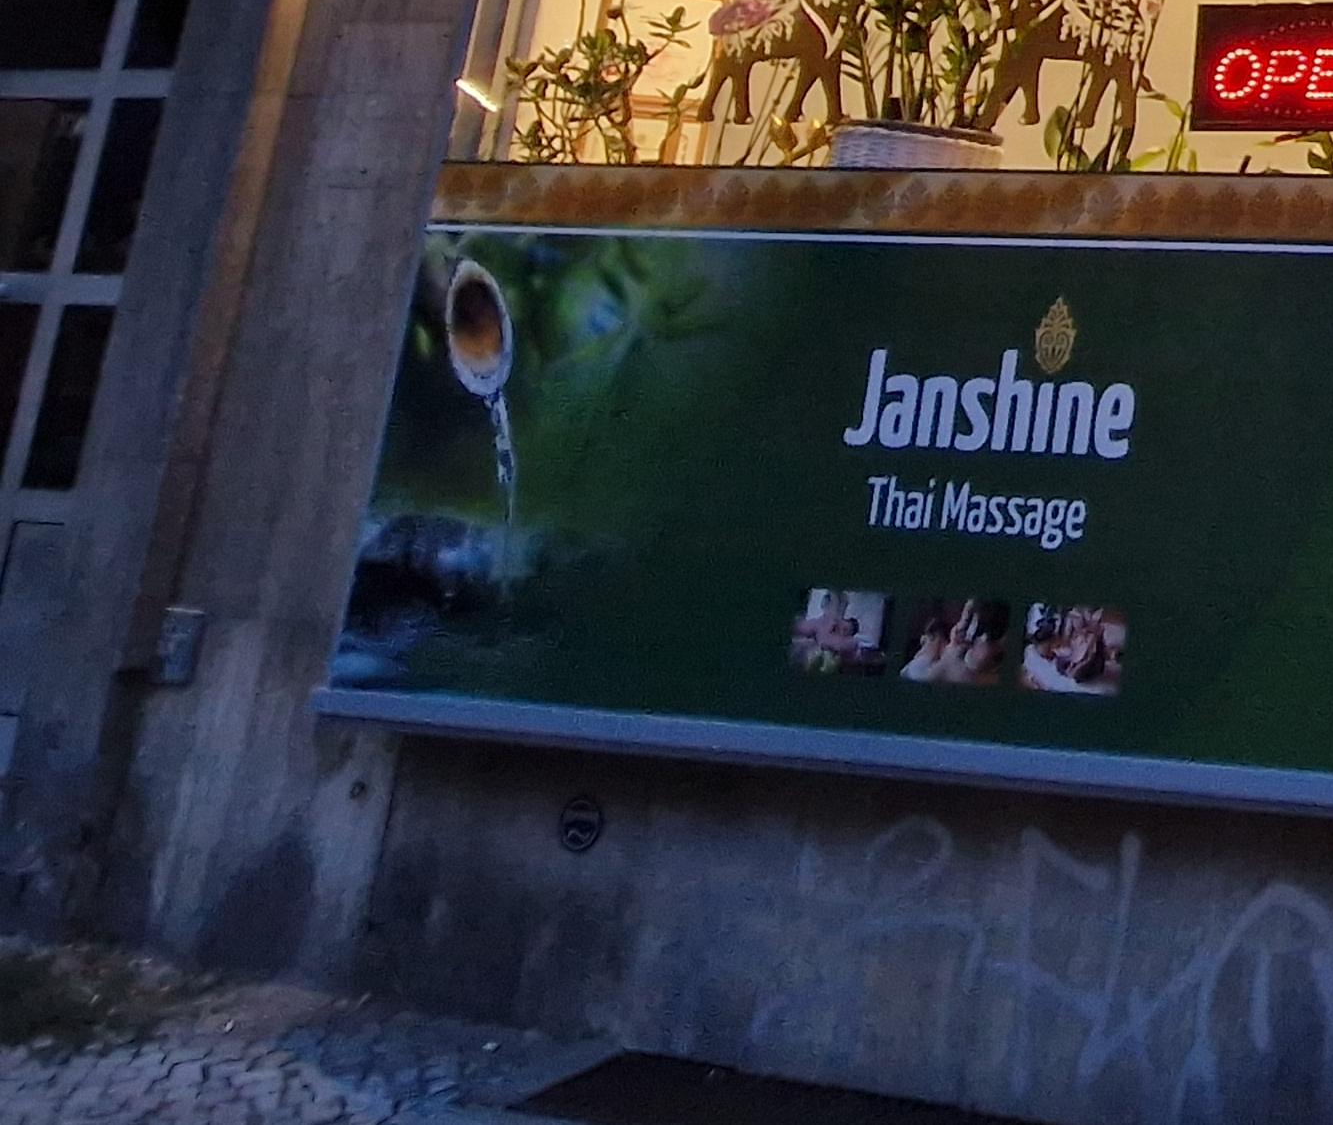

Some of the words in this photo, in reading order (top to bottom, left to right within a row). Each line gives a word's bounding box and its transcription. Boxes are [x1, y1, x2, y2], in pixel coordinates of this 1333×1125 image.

[843, 348, 1136, 459] Janshine
[867, 475, 936, 529] Thai
[940, 479, 1087, 550] Massage
